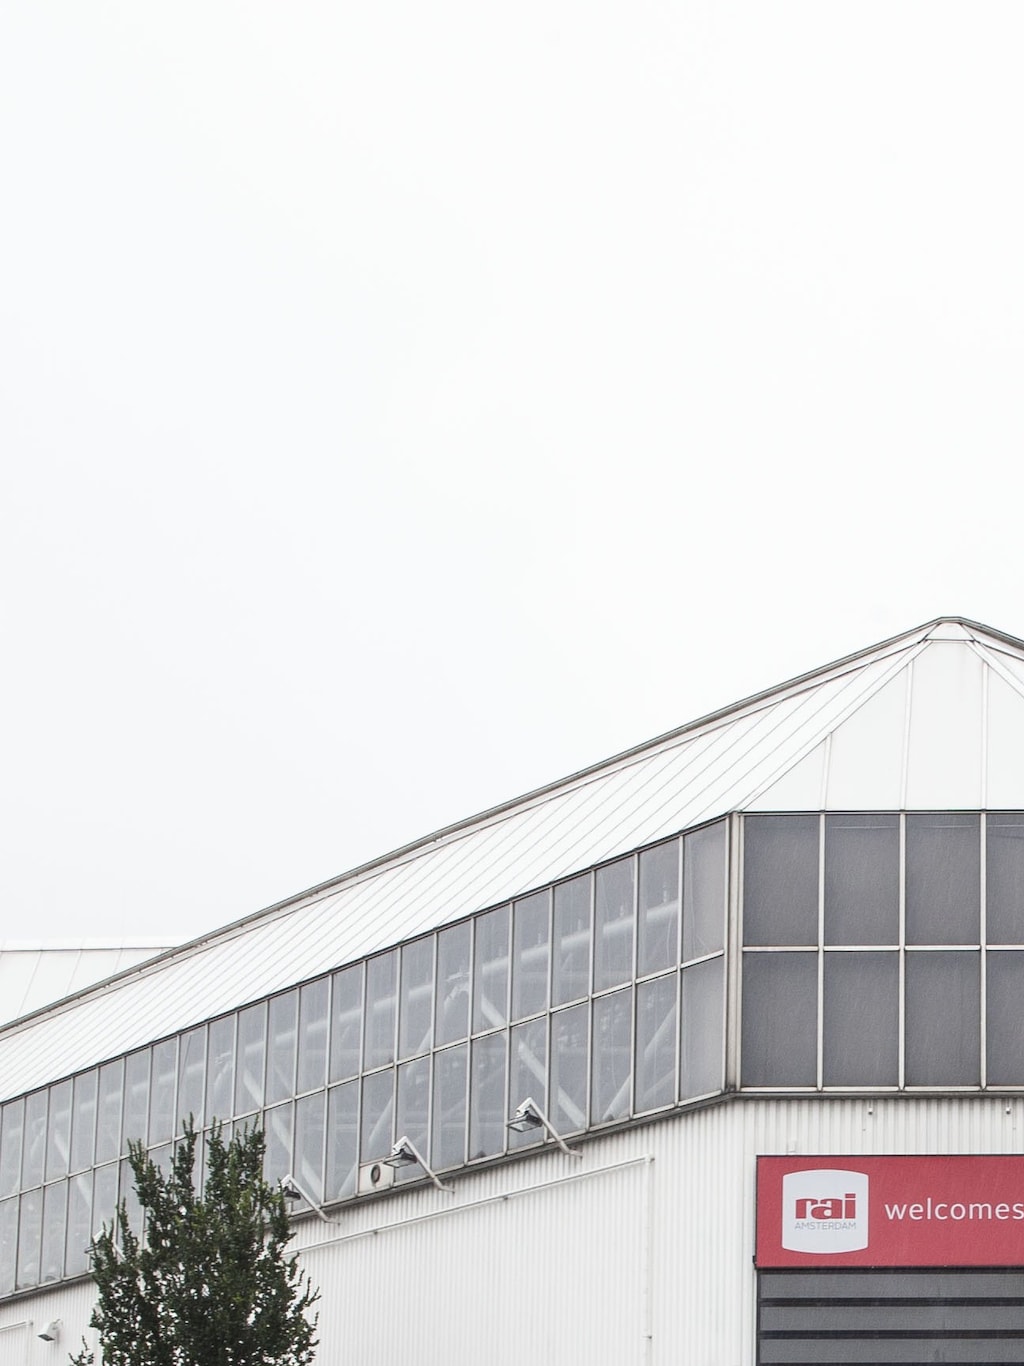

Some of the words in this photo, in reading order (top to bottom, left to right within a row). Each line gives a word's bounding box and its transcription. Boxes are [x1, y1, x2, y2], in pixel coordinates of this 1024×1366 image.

[795, 1193, 856, 1220] rai
[884, 1197, 1024, 1220] welcomes
[794, 1221, 857, 1231] AMSTERDAM
